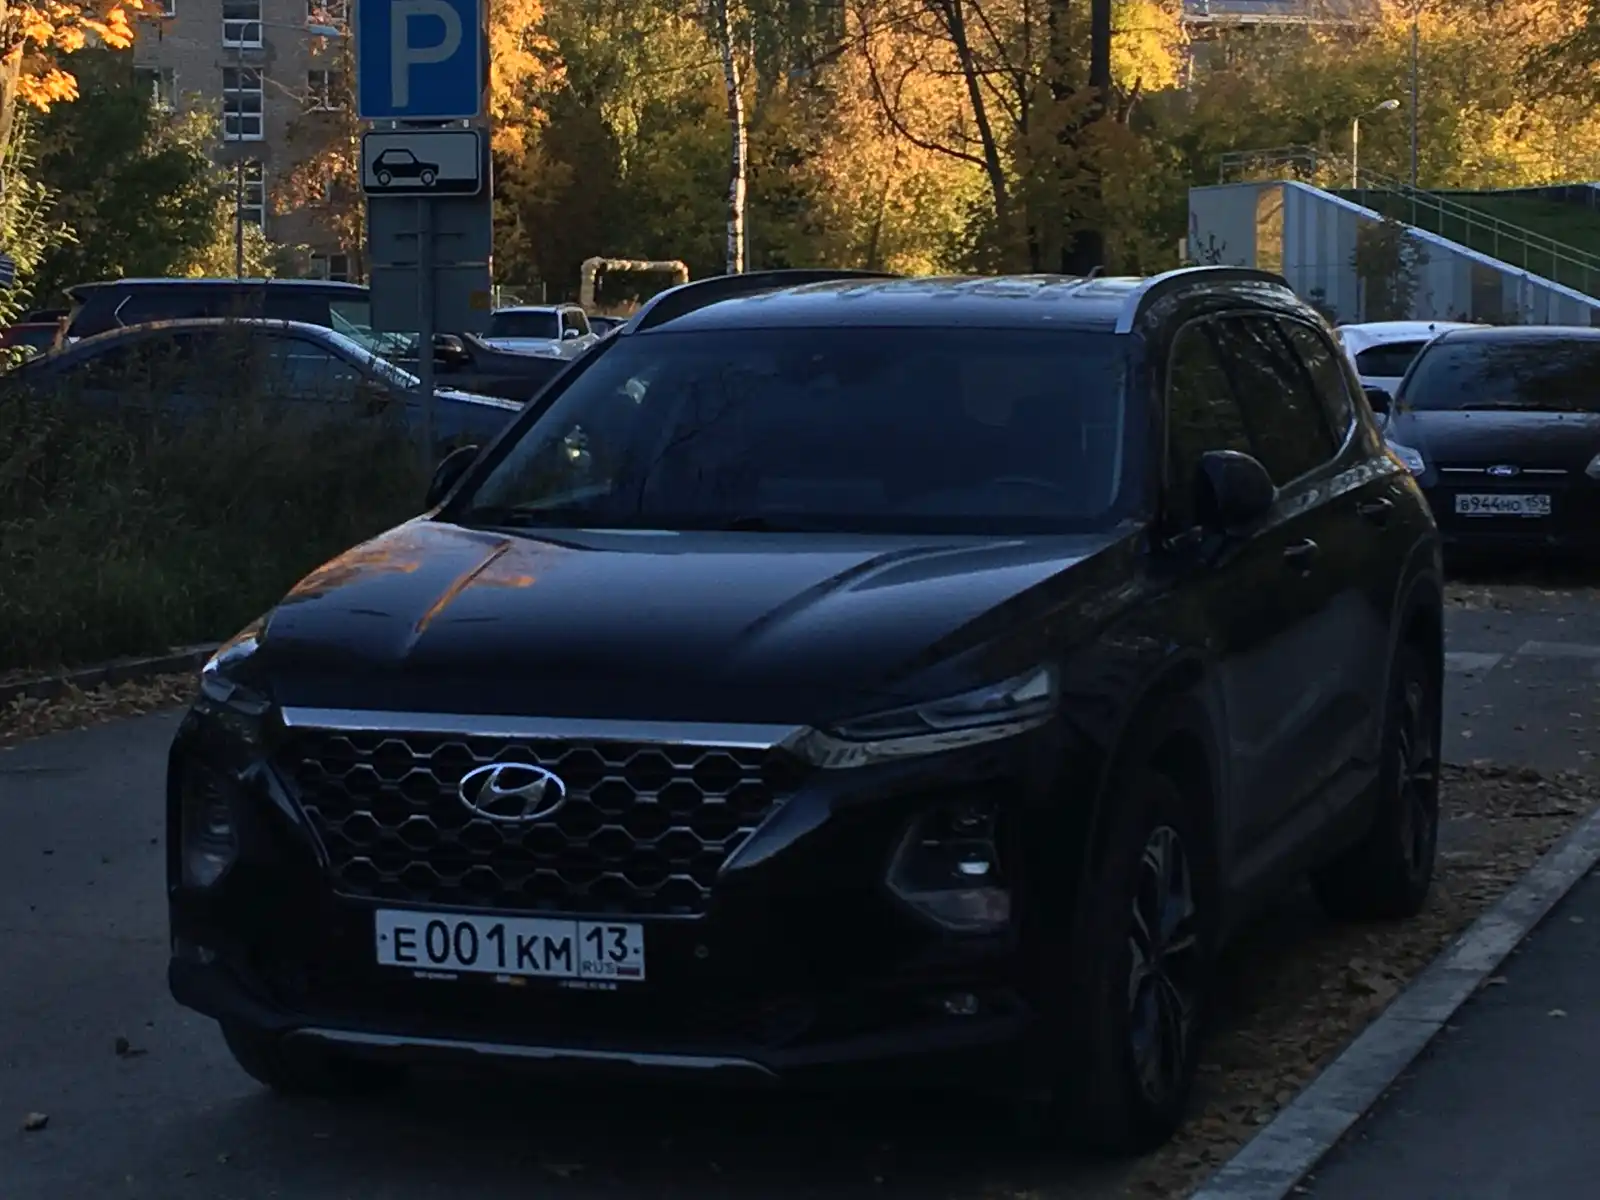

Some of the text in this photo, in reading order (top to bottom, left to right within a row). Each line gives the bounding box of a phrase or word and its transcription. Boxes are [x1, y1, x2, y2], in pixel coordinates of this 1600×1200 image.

[391, 0, 463, 108] P
[586, 926, 628, 962] 13
[582, 961, 615, 975] RUS
